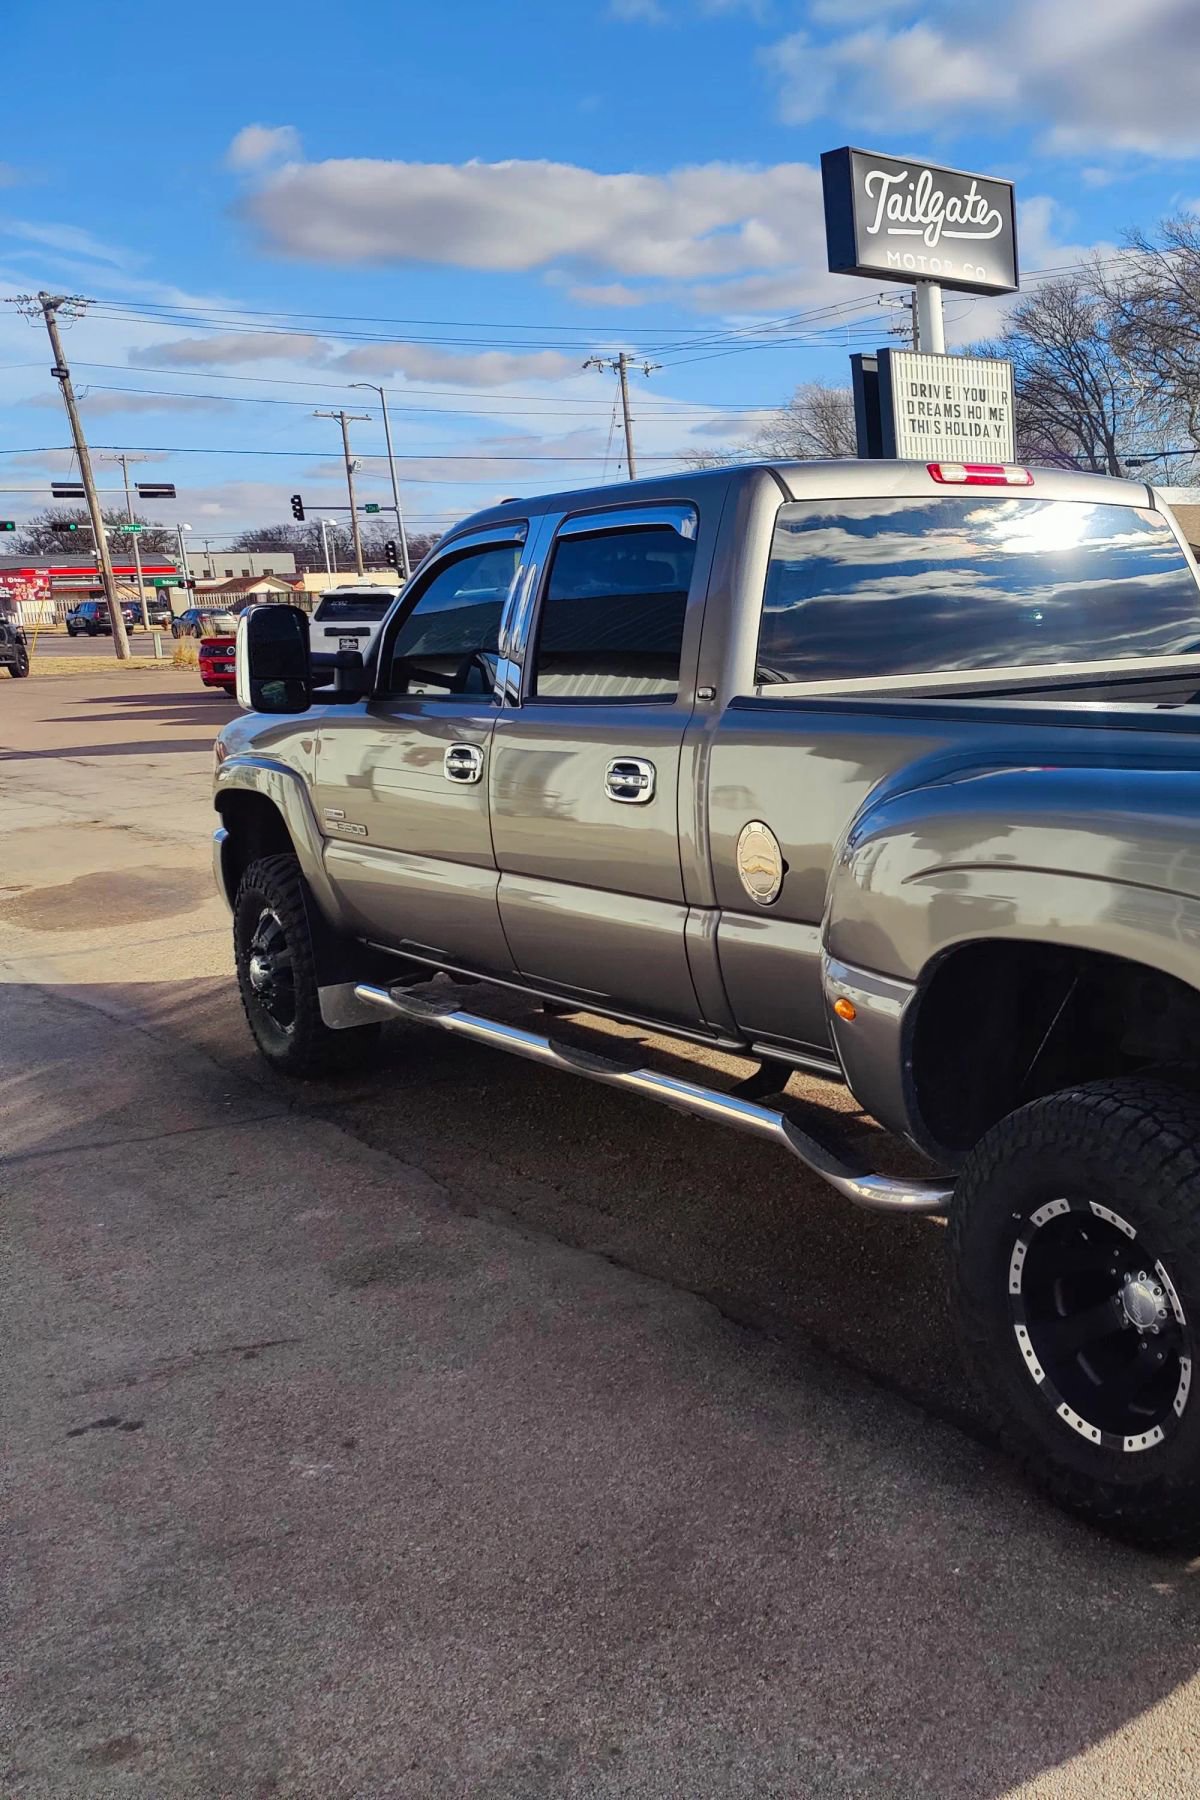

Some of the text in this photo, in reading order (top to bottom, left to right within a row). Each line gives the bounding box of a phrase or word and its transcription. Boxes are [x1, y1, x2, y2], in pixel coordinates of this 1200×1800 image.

[864, 170, 1003, 248] Tailgate
[910, 382, 953, 400] DRIVE
[907, 400, 961, 418] DREAMS
[909, 418, 1002, 439] THIS HOLIDAY
[337, 821, 367, 835] 3500
